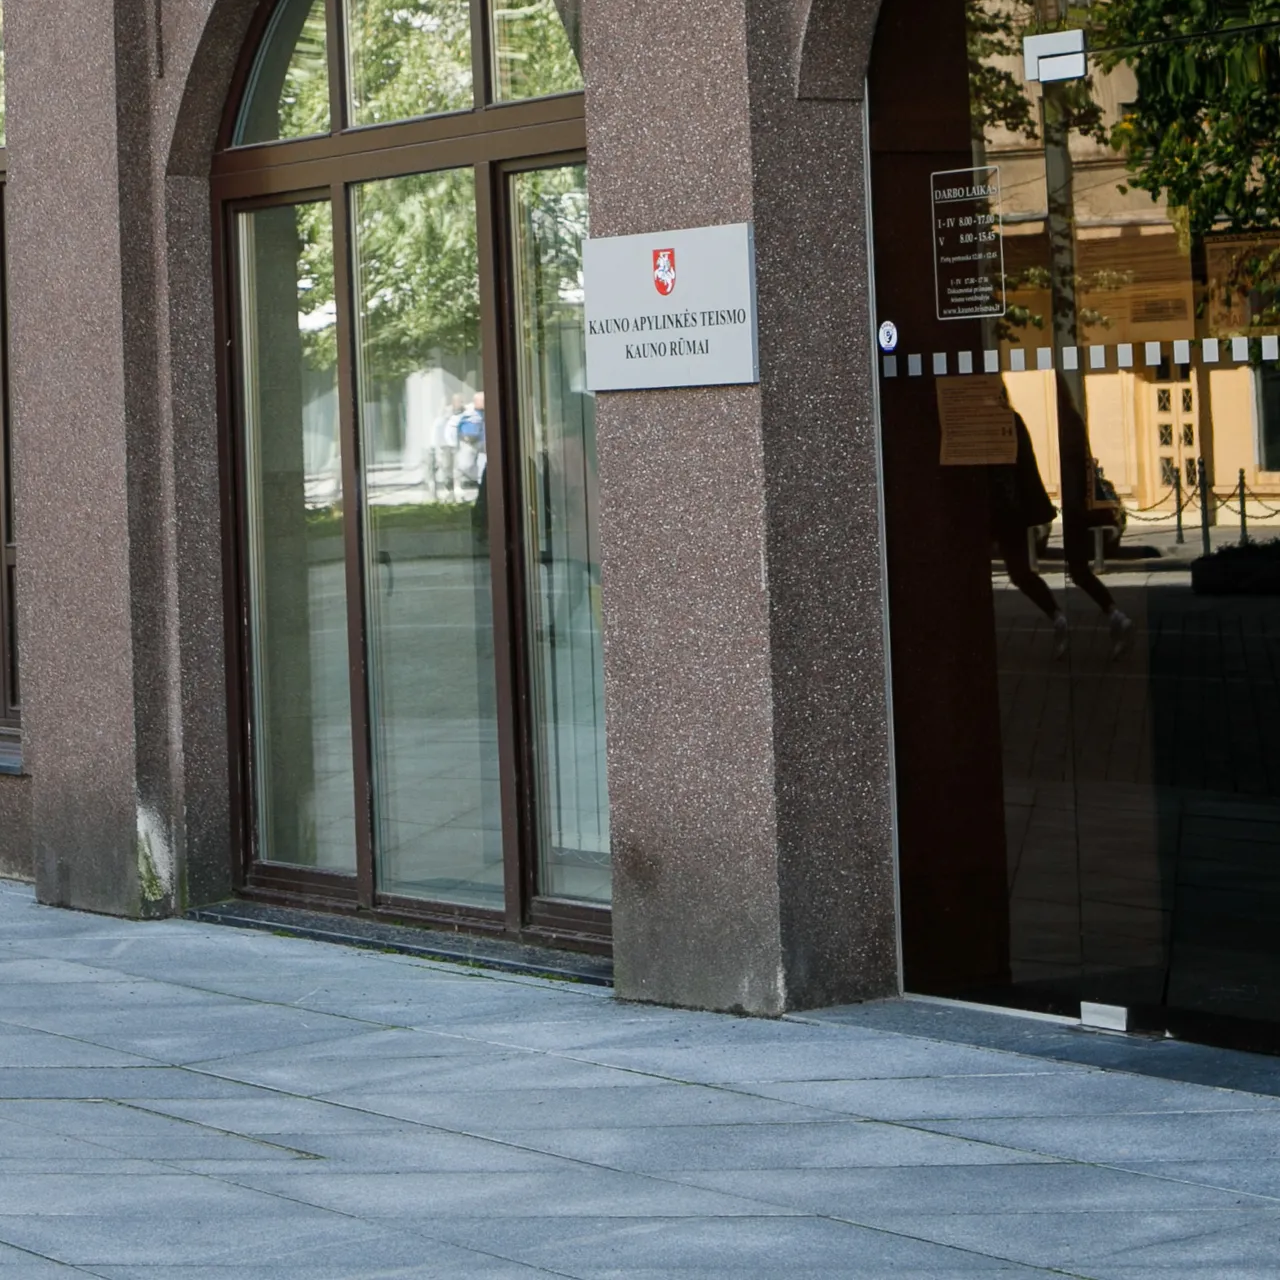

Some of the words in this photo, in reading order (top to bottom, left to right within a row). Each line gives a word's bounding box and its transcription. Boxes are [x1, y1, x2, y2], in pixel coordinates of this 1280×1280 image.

[934, 187, 965, 201] DARBO
[966, 184, 998, 197] LAIKAS
[947, 217, 956, 228] IV
[959, 216, 973, 227] 8.00
[978, 214, 995, 225] 17.00
[939, 236, 945, 247] V
[960, 232, 974, 244] 8.00
[588, 317, 630, 335] KAUNO
[631, 308, 698, 333] APYLINKĖS
[699, 308, 746, 327] TEISMO
[625, 341, 667, 360] KAUNO
[669, 337, 709, 356] RŪMAI
